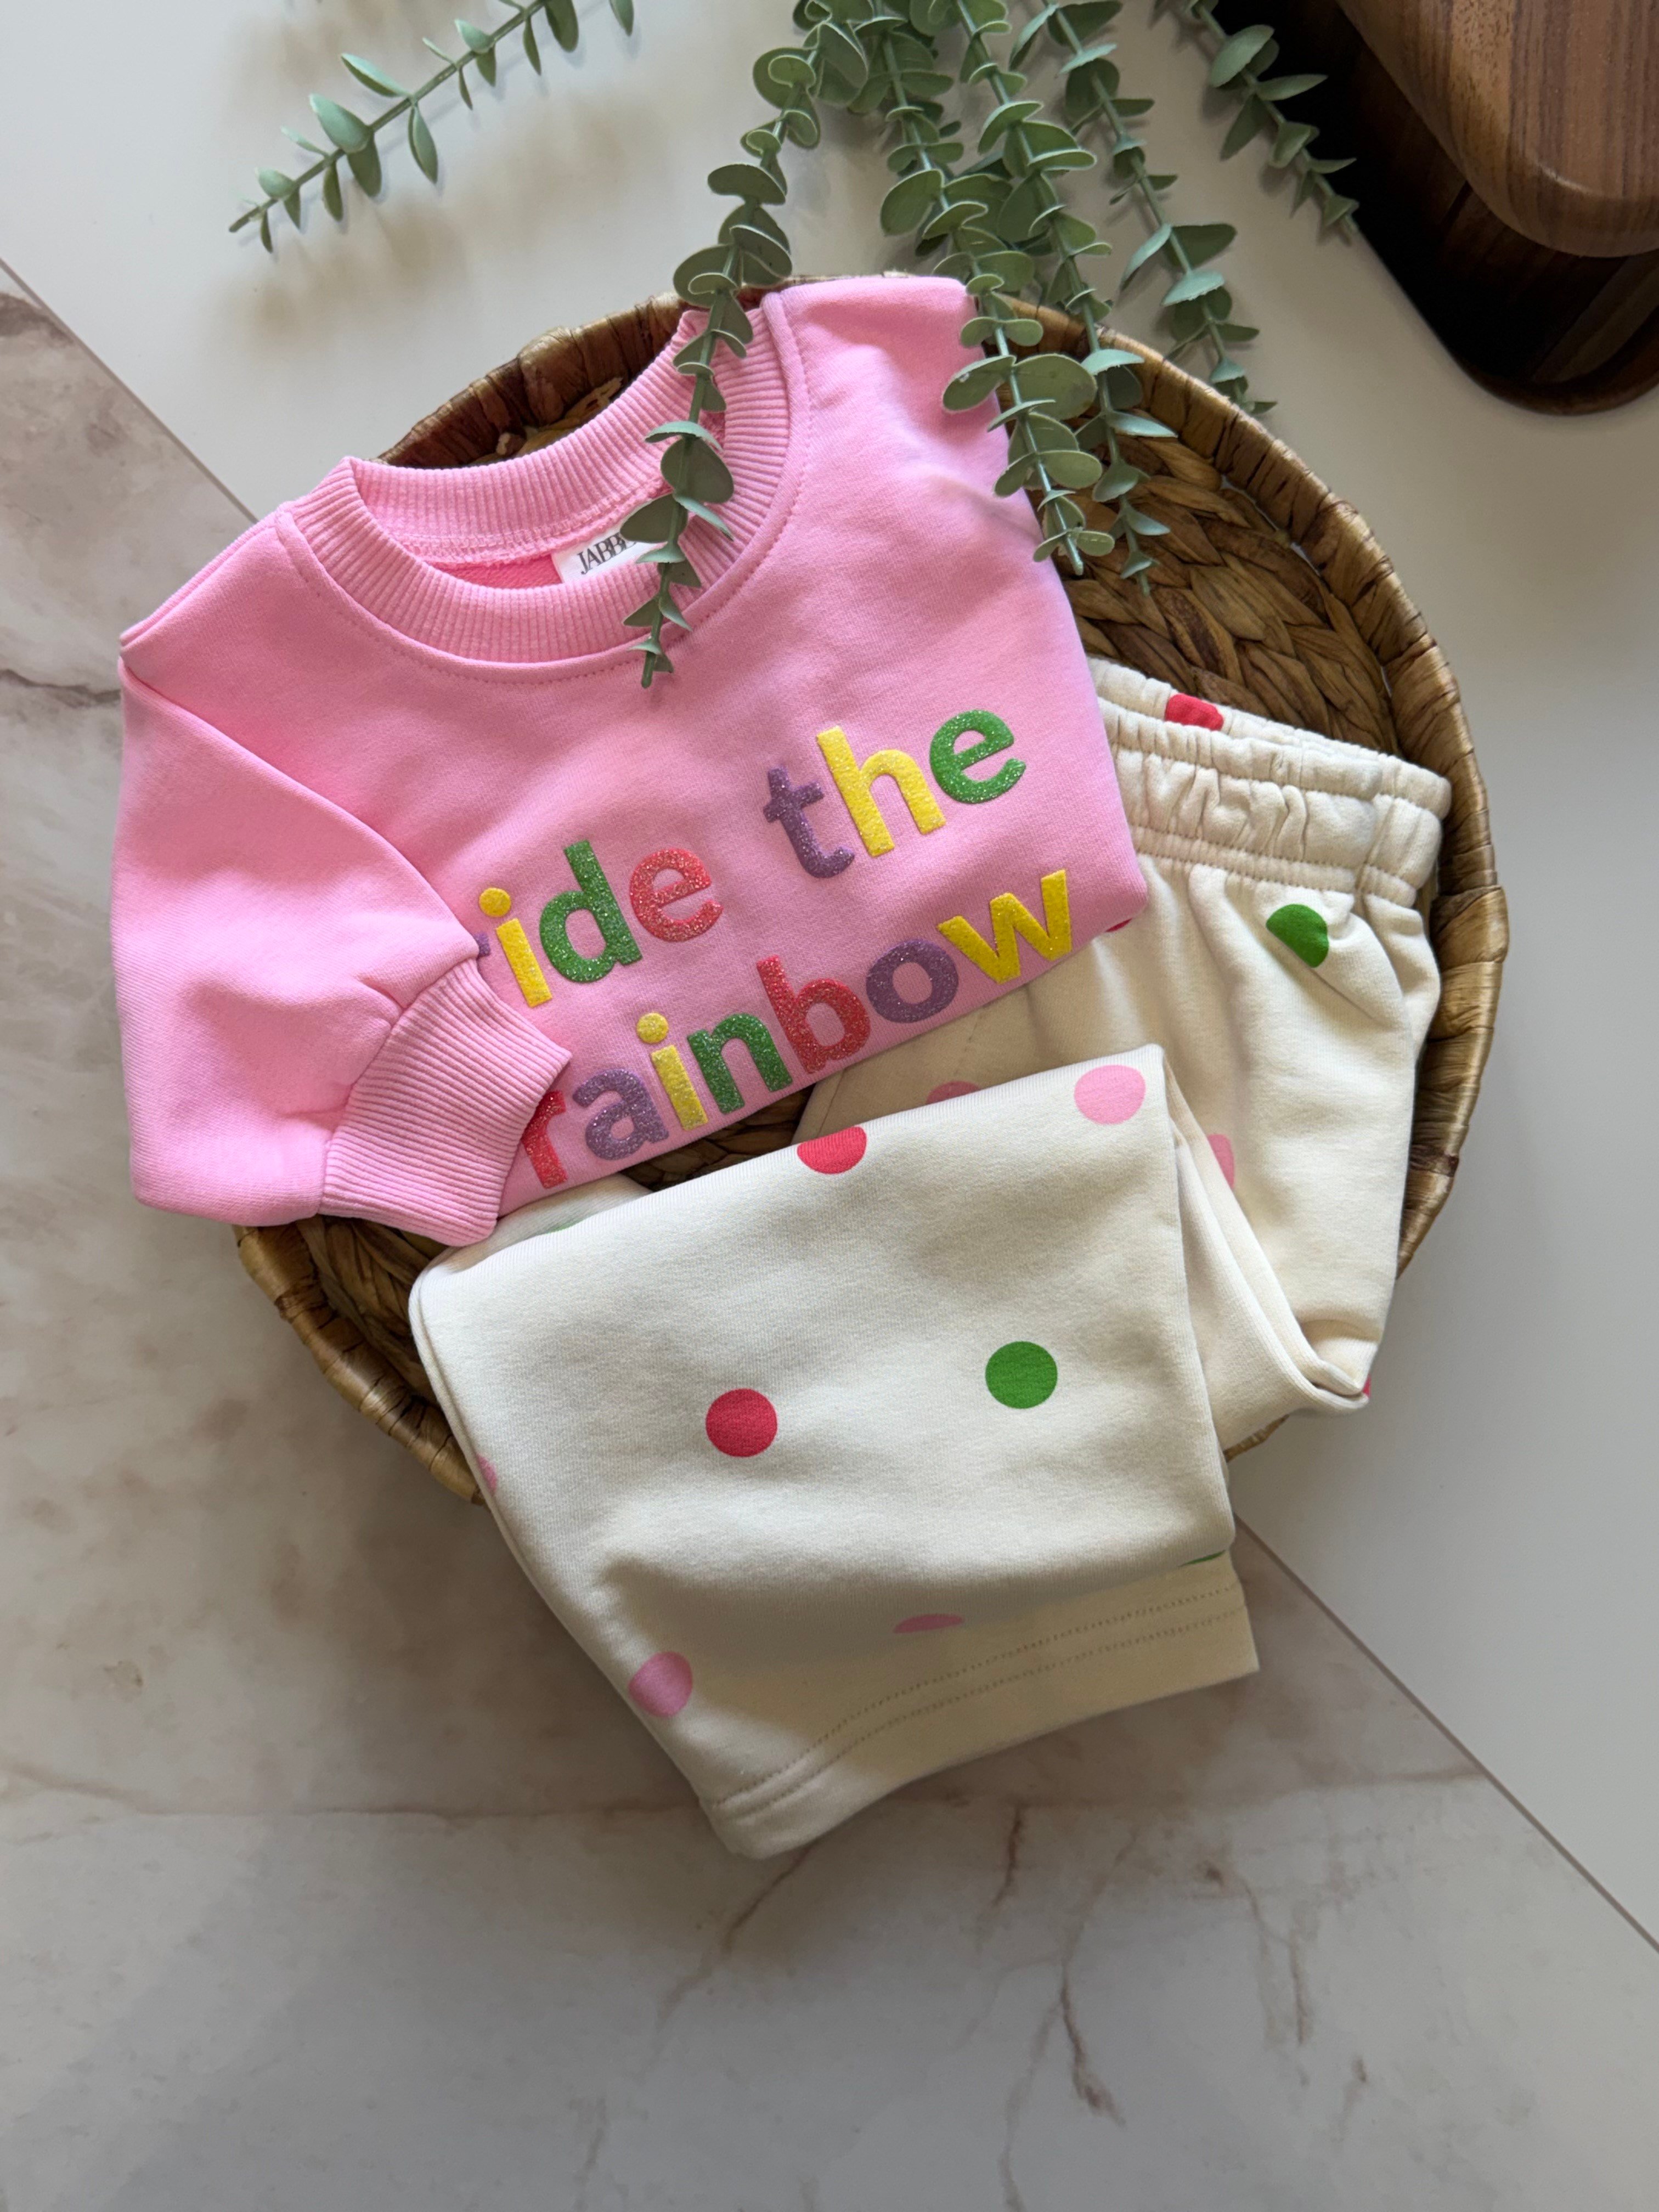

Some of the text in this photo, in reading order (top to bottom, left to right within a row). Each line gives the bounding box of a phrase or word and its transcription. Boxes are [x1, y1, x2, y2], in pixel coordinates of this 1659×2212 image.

[478, 709, 1026, 1008] ide the
[521, 869, 1072, 1189] rainbow
